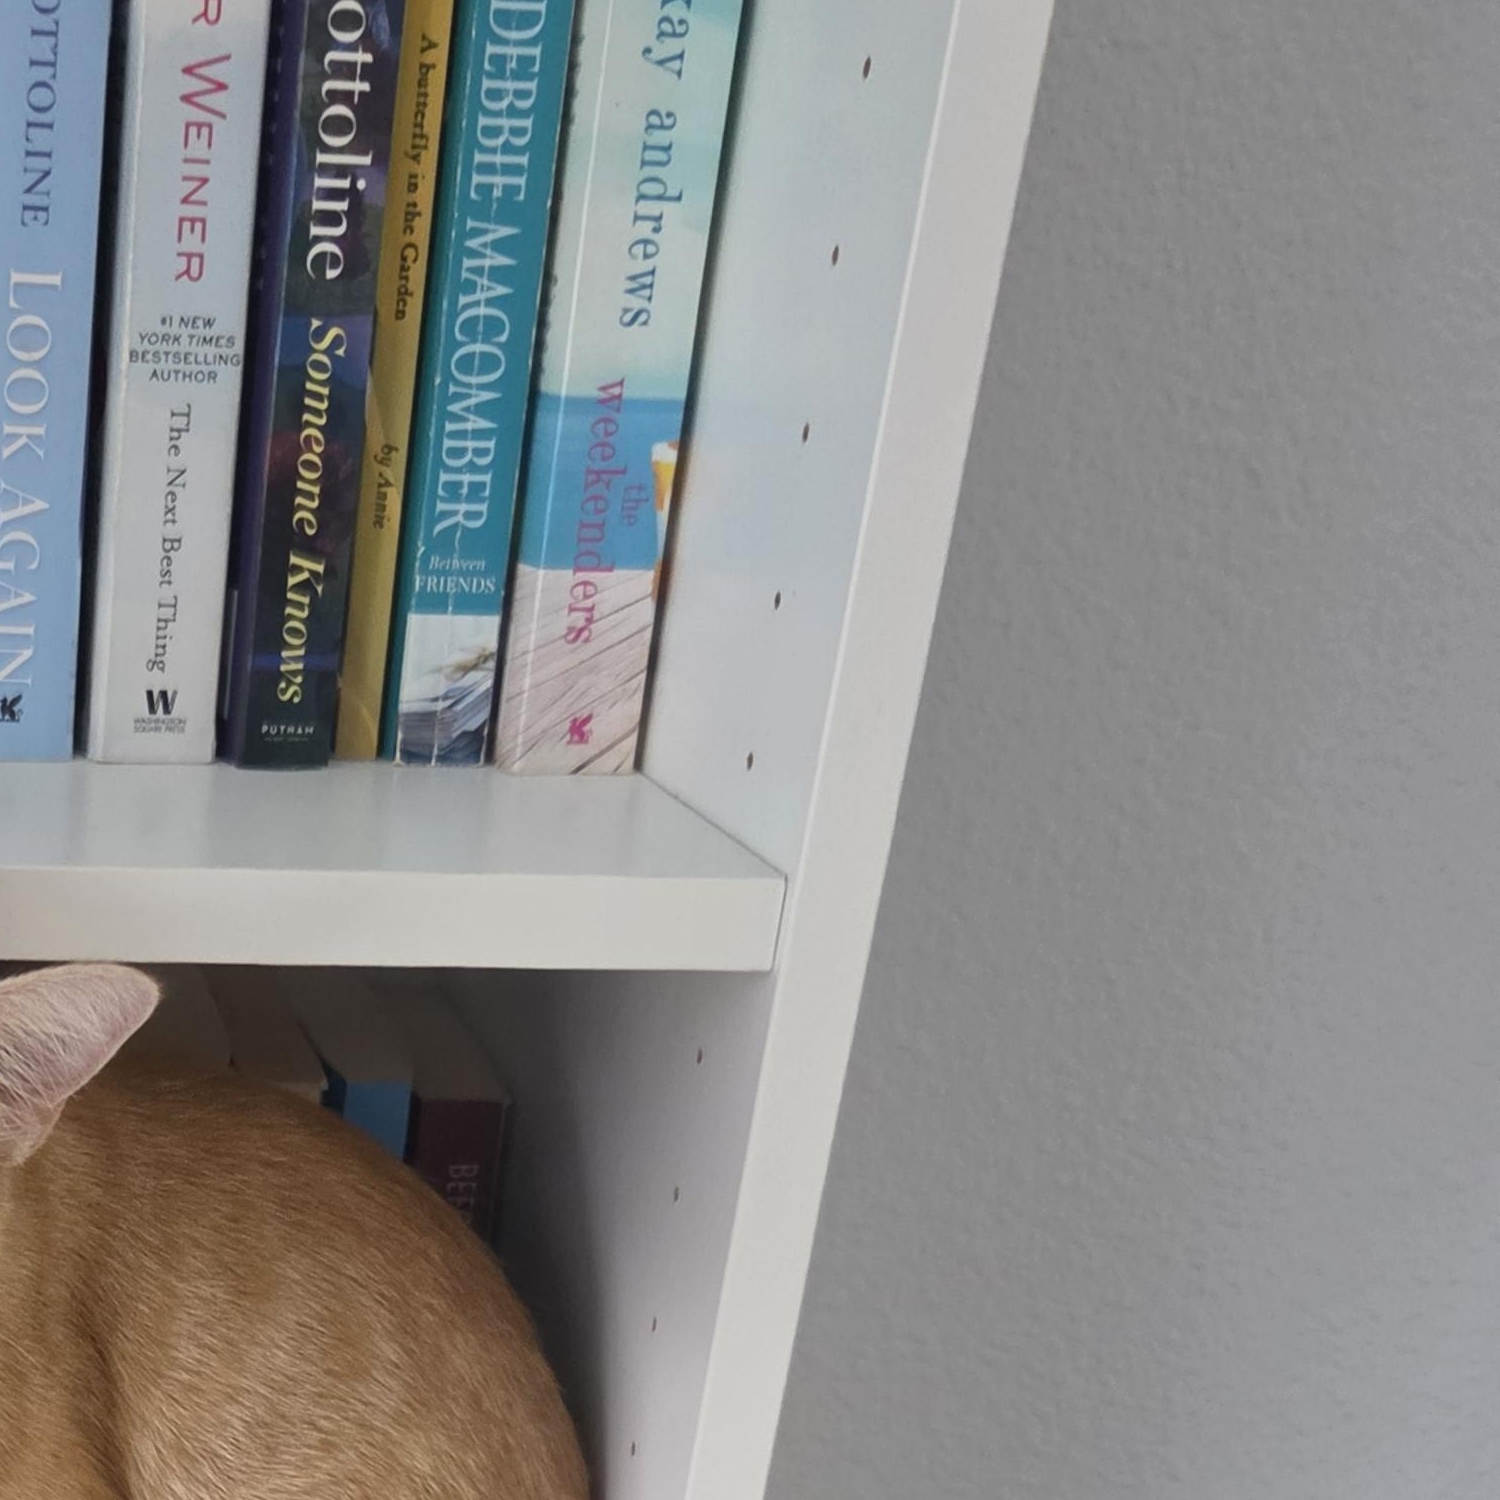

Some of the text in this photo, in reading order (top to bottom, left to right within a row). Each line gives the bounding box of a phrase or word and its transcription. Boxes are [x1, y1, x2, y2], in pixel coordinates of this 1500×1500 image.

[306, 0, 374, 280] ottoline
[404, 58, 437, 166] butterfly
[174, 53, 232, 283] WEINER
[406, 172, 426, 194] in
[402, 198, 422, 237] the
[619, 108, 683, 328] andrews
[394, 244, 419, 321] Garden
[433, 0, 548, 539] DEBBIE MACOMBER
[129, 350, 241, 368] BESTSELLING
[138, 332, 236, 349] YORK TIMES
[178, 316, 216, 331] NEW
[0, 267, 63, 461] LOOK
[149, 369, 218, 384] AUTHOR
[291, 317, 347, 536] Someone
[373, 442, 399, 531] by Annie
[564, 377, 628, 645] weekenders
[621, 482, 649, 527] the
[145, 403, 192, 673] The Next Best Thing
[428, 555, 486, 572] Between
[415, 574, 496, 594] FRIENDS
[277, 549, 326, 705] Knows
[133, 725, 186, 734] SQUARE PRESS
[261, 724, 315, 736] PUTNAM
